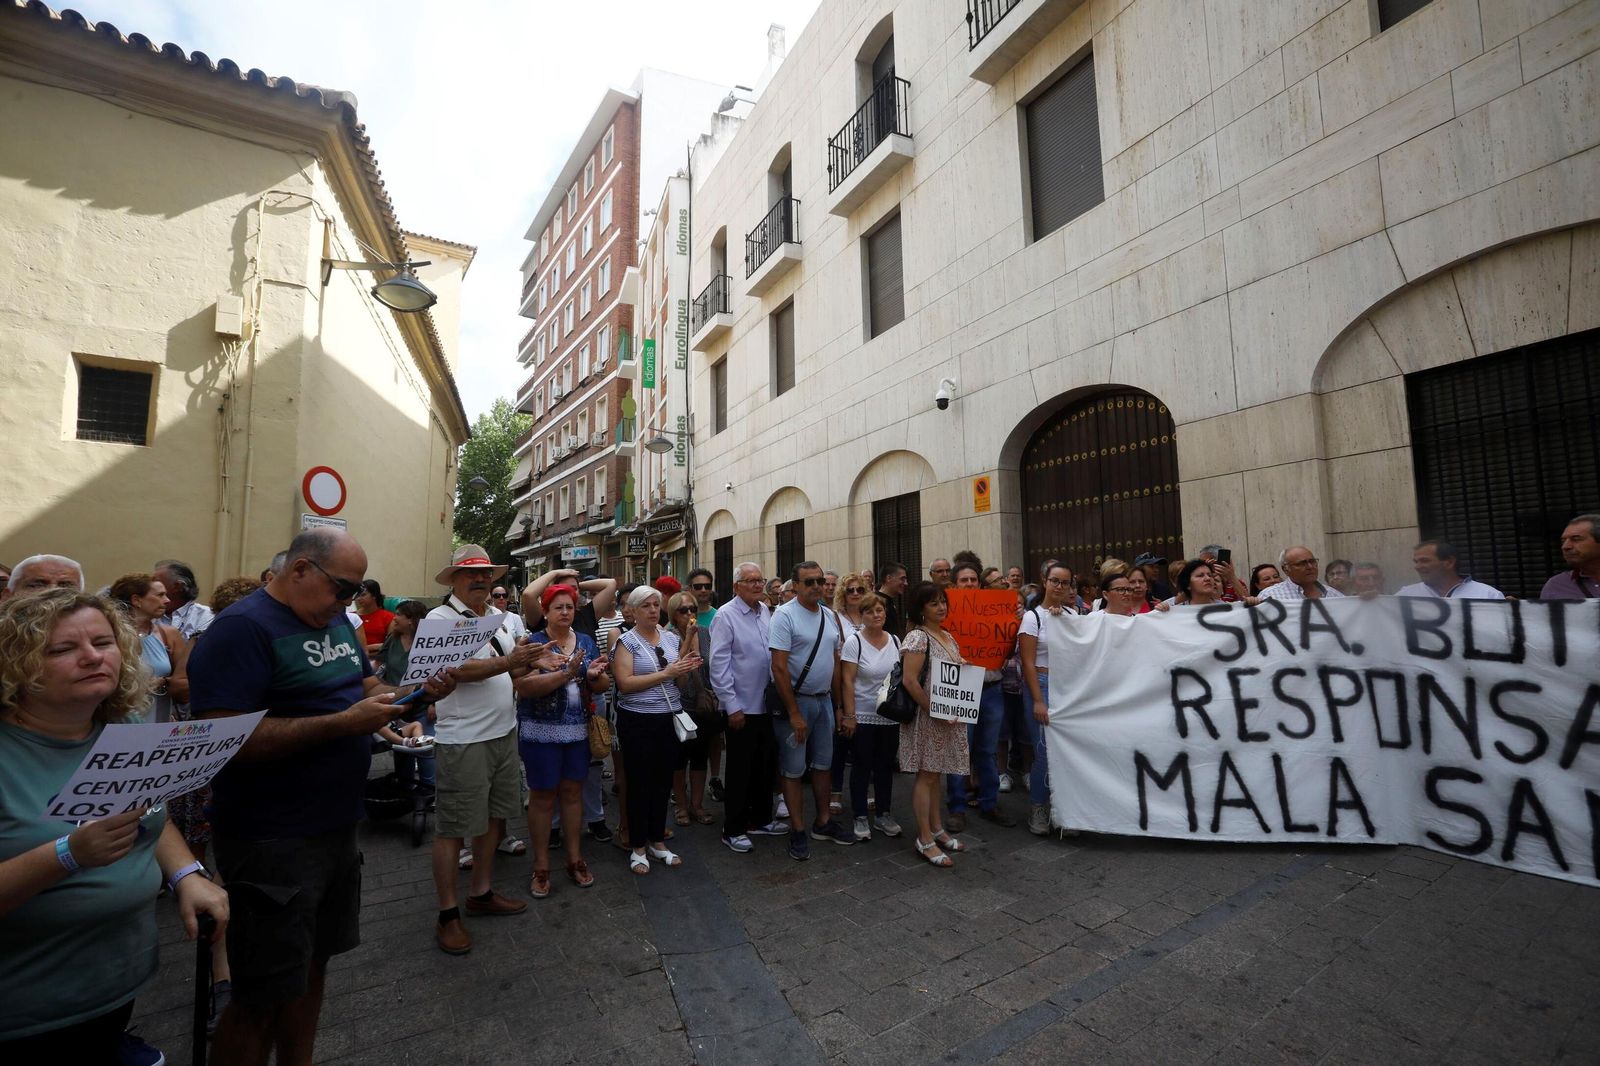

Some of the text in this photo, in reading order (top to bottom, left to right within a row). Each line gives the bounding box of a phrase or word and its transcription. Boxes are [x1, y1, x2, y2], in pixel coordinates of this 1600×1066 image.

[677, 208, 688, 256] idiomas
[675, 299, 688, 371] Eurolingua
[646, 346, 654, 382] idiomas
[674, 415, 686, 467] idiomas
[573, 545, 596, 557] yupis
[629, 537, 647, 546] MIA
[415, 628, 498, 649] REAPERTURA
[943, 621, 1018, 641] ALUD NO
[1197, 596, 1600, 667] SRA. BOT
[411, 653, 460, 665] CENTRO
[403, 668, 431, 681] LOS
[941, 663, 959, 684] NO
[932, 684, 975, 702] AL CIERRE DEL
[930, 701, 978, 719] CENTRO MÉDICO
[85, 733, 246, 770] REAPERTURA
[73, 757, 228, 795] CENTRO SALUD
[1134, 750, 1376, 838] MALA
[50, 802, 115, 817] LOS
